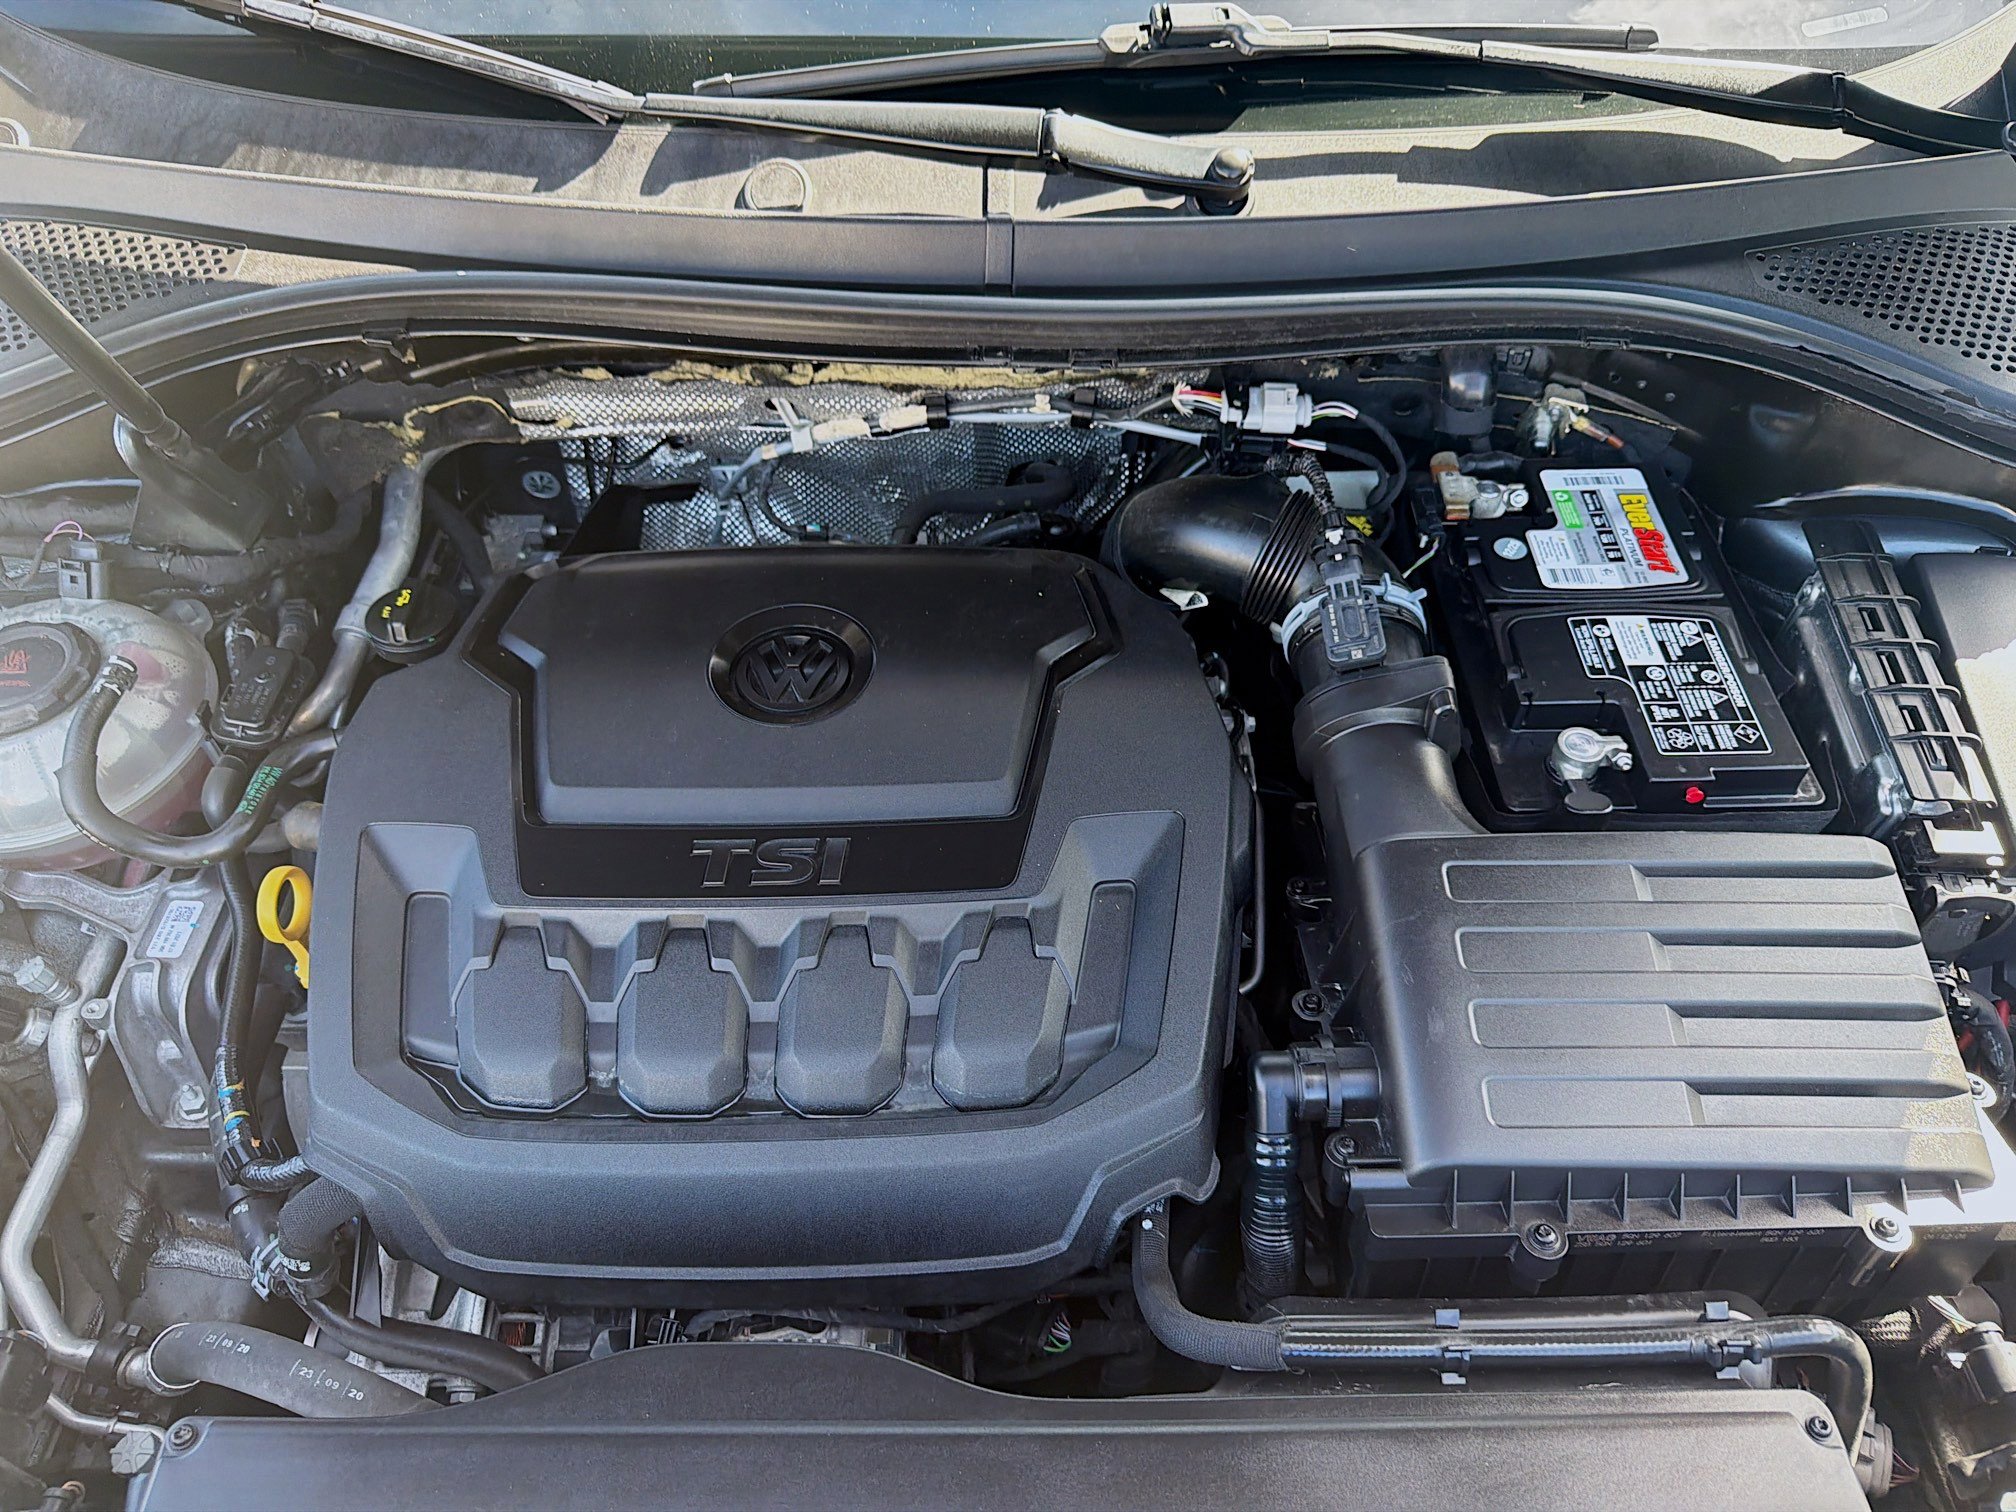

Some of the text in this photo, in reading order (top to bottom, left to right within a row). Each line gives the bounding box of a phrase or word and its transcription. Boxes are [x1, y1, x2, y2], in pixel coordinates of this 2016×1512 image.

[1617, 494, 1678, 574] EverStart
[1619, 528, 1644, 567] PLATINUM
[690, 838, 851, 887] TSI
